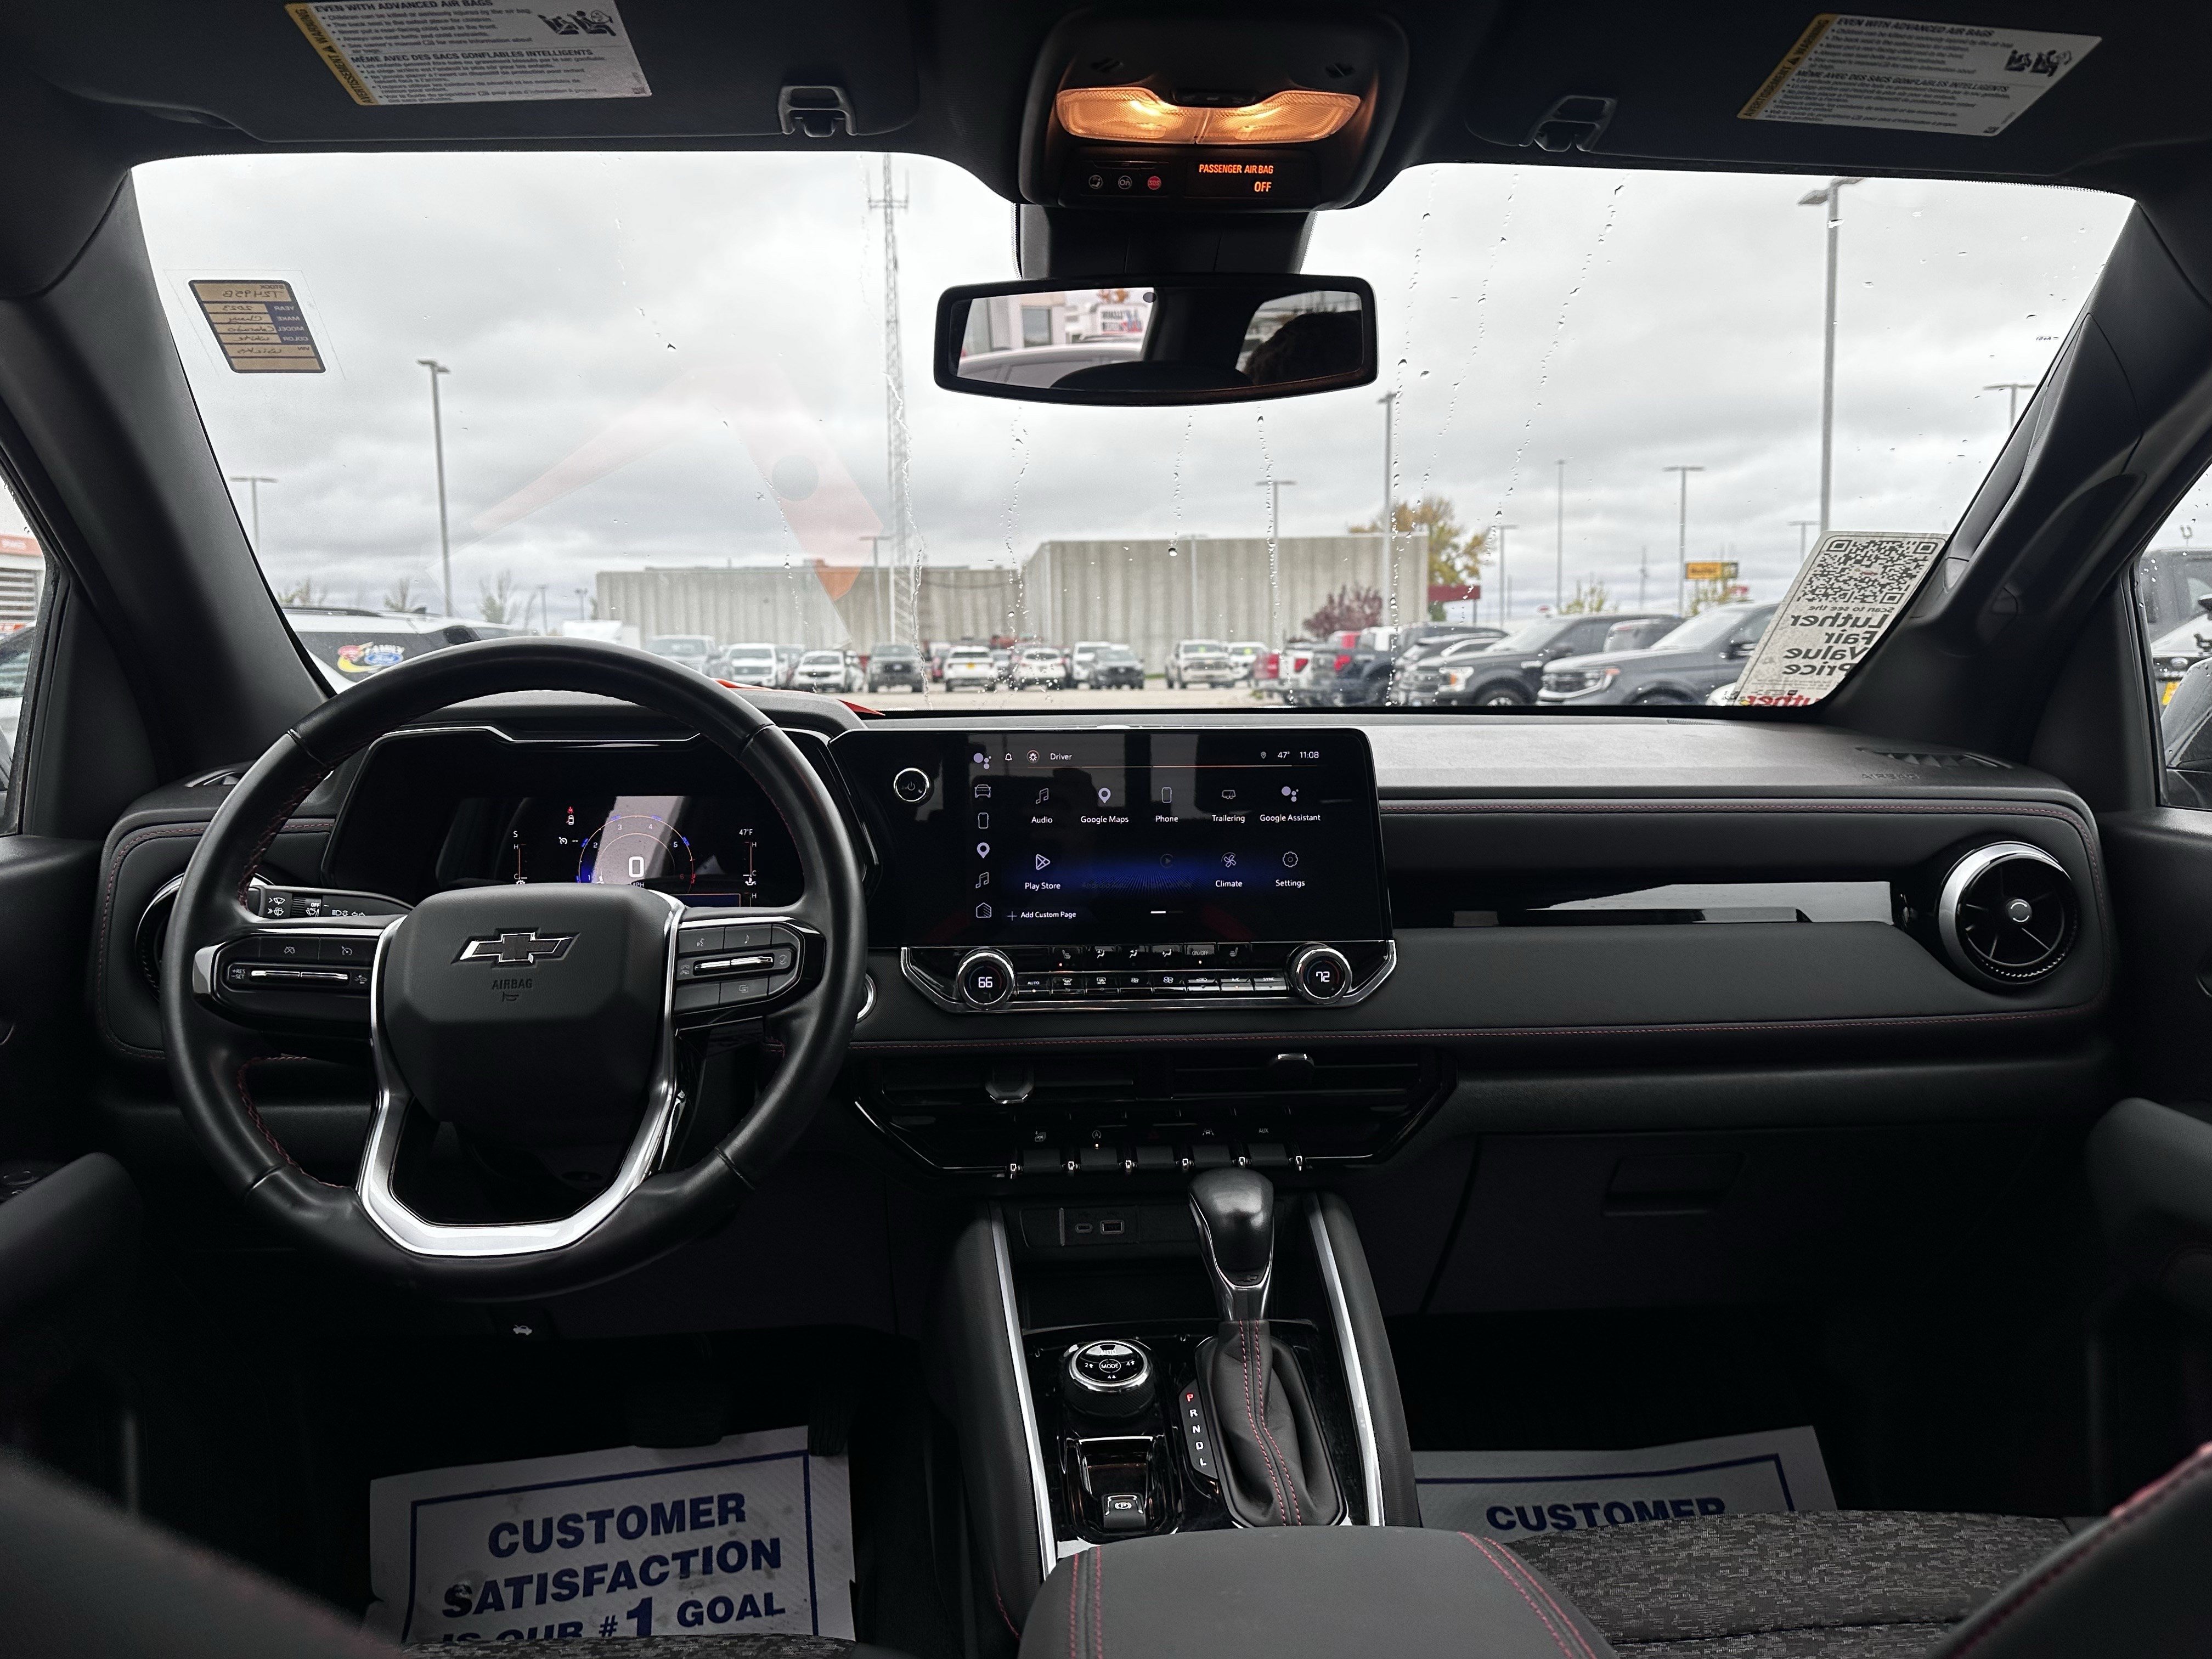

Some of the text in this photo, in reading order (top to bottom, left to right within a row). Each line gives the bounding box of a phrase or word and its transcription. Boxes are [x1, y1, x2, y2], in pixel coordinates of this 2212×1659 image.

[378, 1, 438, 9] ADVANCED
[461, 51, 523, 59] GONFLABLES
[1199, 164, 1273, 174] PASSENGER AIR BAG
[1254, 182, 1272, 192] OFF
[1050, 753, 1072, 761] Driver
[1278, 751, 1290, 759] 47°
[1299, 751, 1319, 759] 11:08
[1031, 815, 1053, 823] Audio
[1081, 815, 1129, 825] Google Maps
[1155, 815, 1178, 823] Phone
[1211, 814, 1245, 824] Trailering
[1260, 814, 1321, 823] Google Assistant
[628, 856, 644, 878] 0
[1025, 882, 1060, 891] Play Store
[1215, 879, 1243, 888] Climate
[1276, 879, 1305, 889] Settings
[1062, 911, 1077, 920] Page
[1316, 971, 1330, 983] 72
[492, 979, 533, 990] AIRBAG
[978, 977, 993, 988] 66
[1187, 1393, 1194, 1402] P
[1189, 1409, 1198, 1417] R
[1192, 1425, 1200, 1434] N
[1196, 1441, 1204, 1450] D
[1200, 1458, 1207, 1466] L
[1486, 1498, 1725, 1531] CUSTOMER
[488, 1493, 746, 1558] CUSTOMER
[442, 1537, 781, 1618] SATISFACTION
[676, 1593, 786, 1628] GOAL
